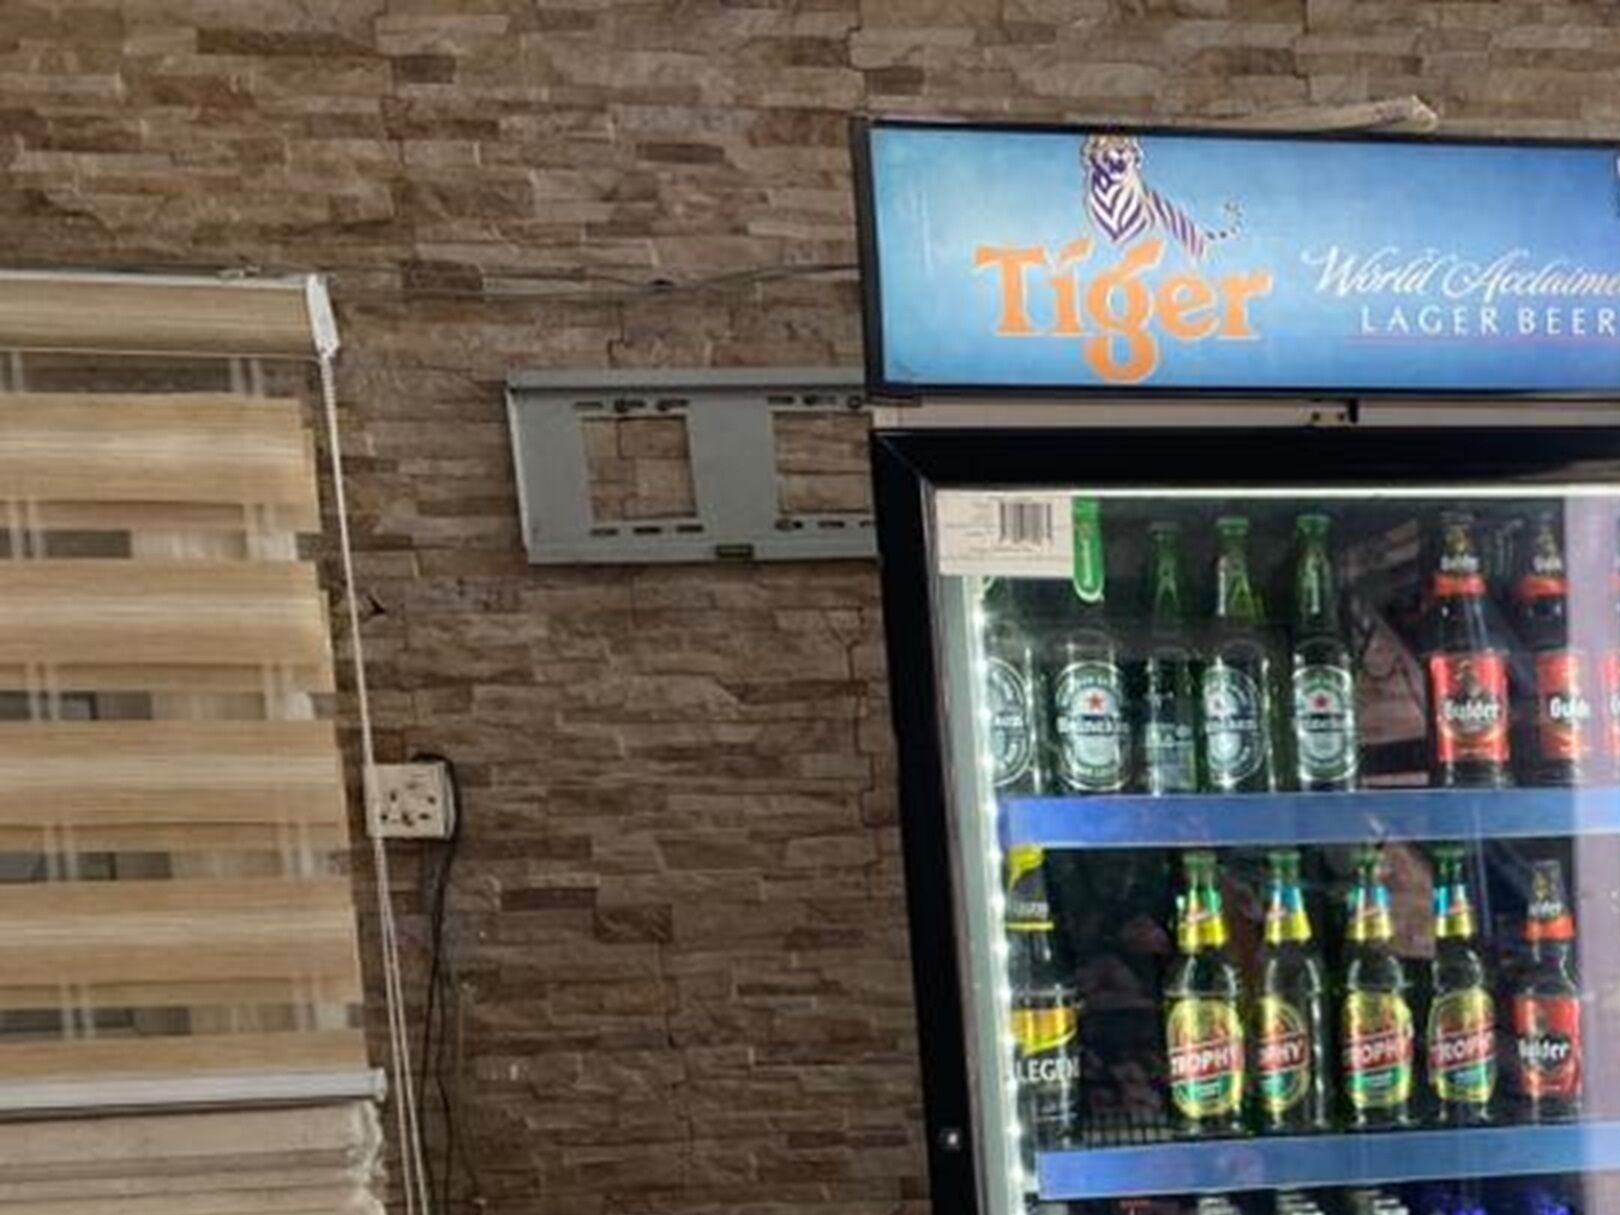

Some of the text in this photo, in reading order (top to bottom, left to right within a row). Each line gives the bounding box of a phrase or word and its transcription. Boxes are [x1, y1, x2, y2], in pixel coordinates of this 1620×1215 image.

[1301, 245, 1447, 298] World
[975, 238, 1272, 383] Tiger
[1361, 306, 1616, 336] LAGER BEER
